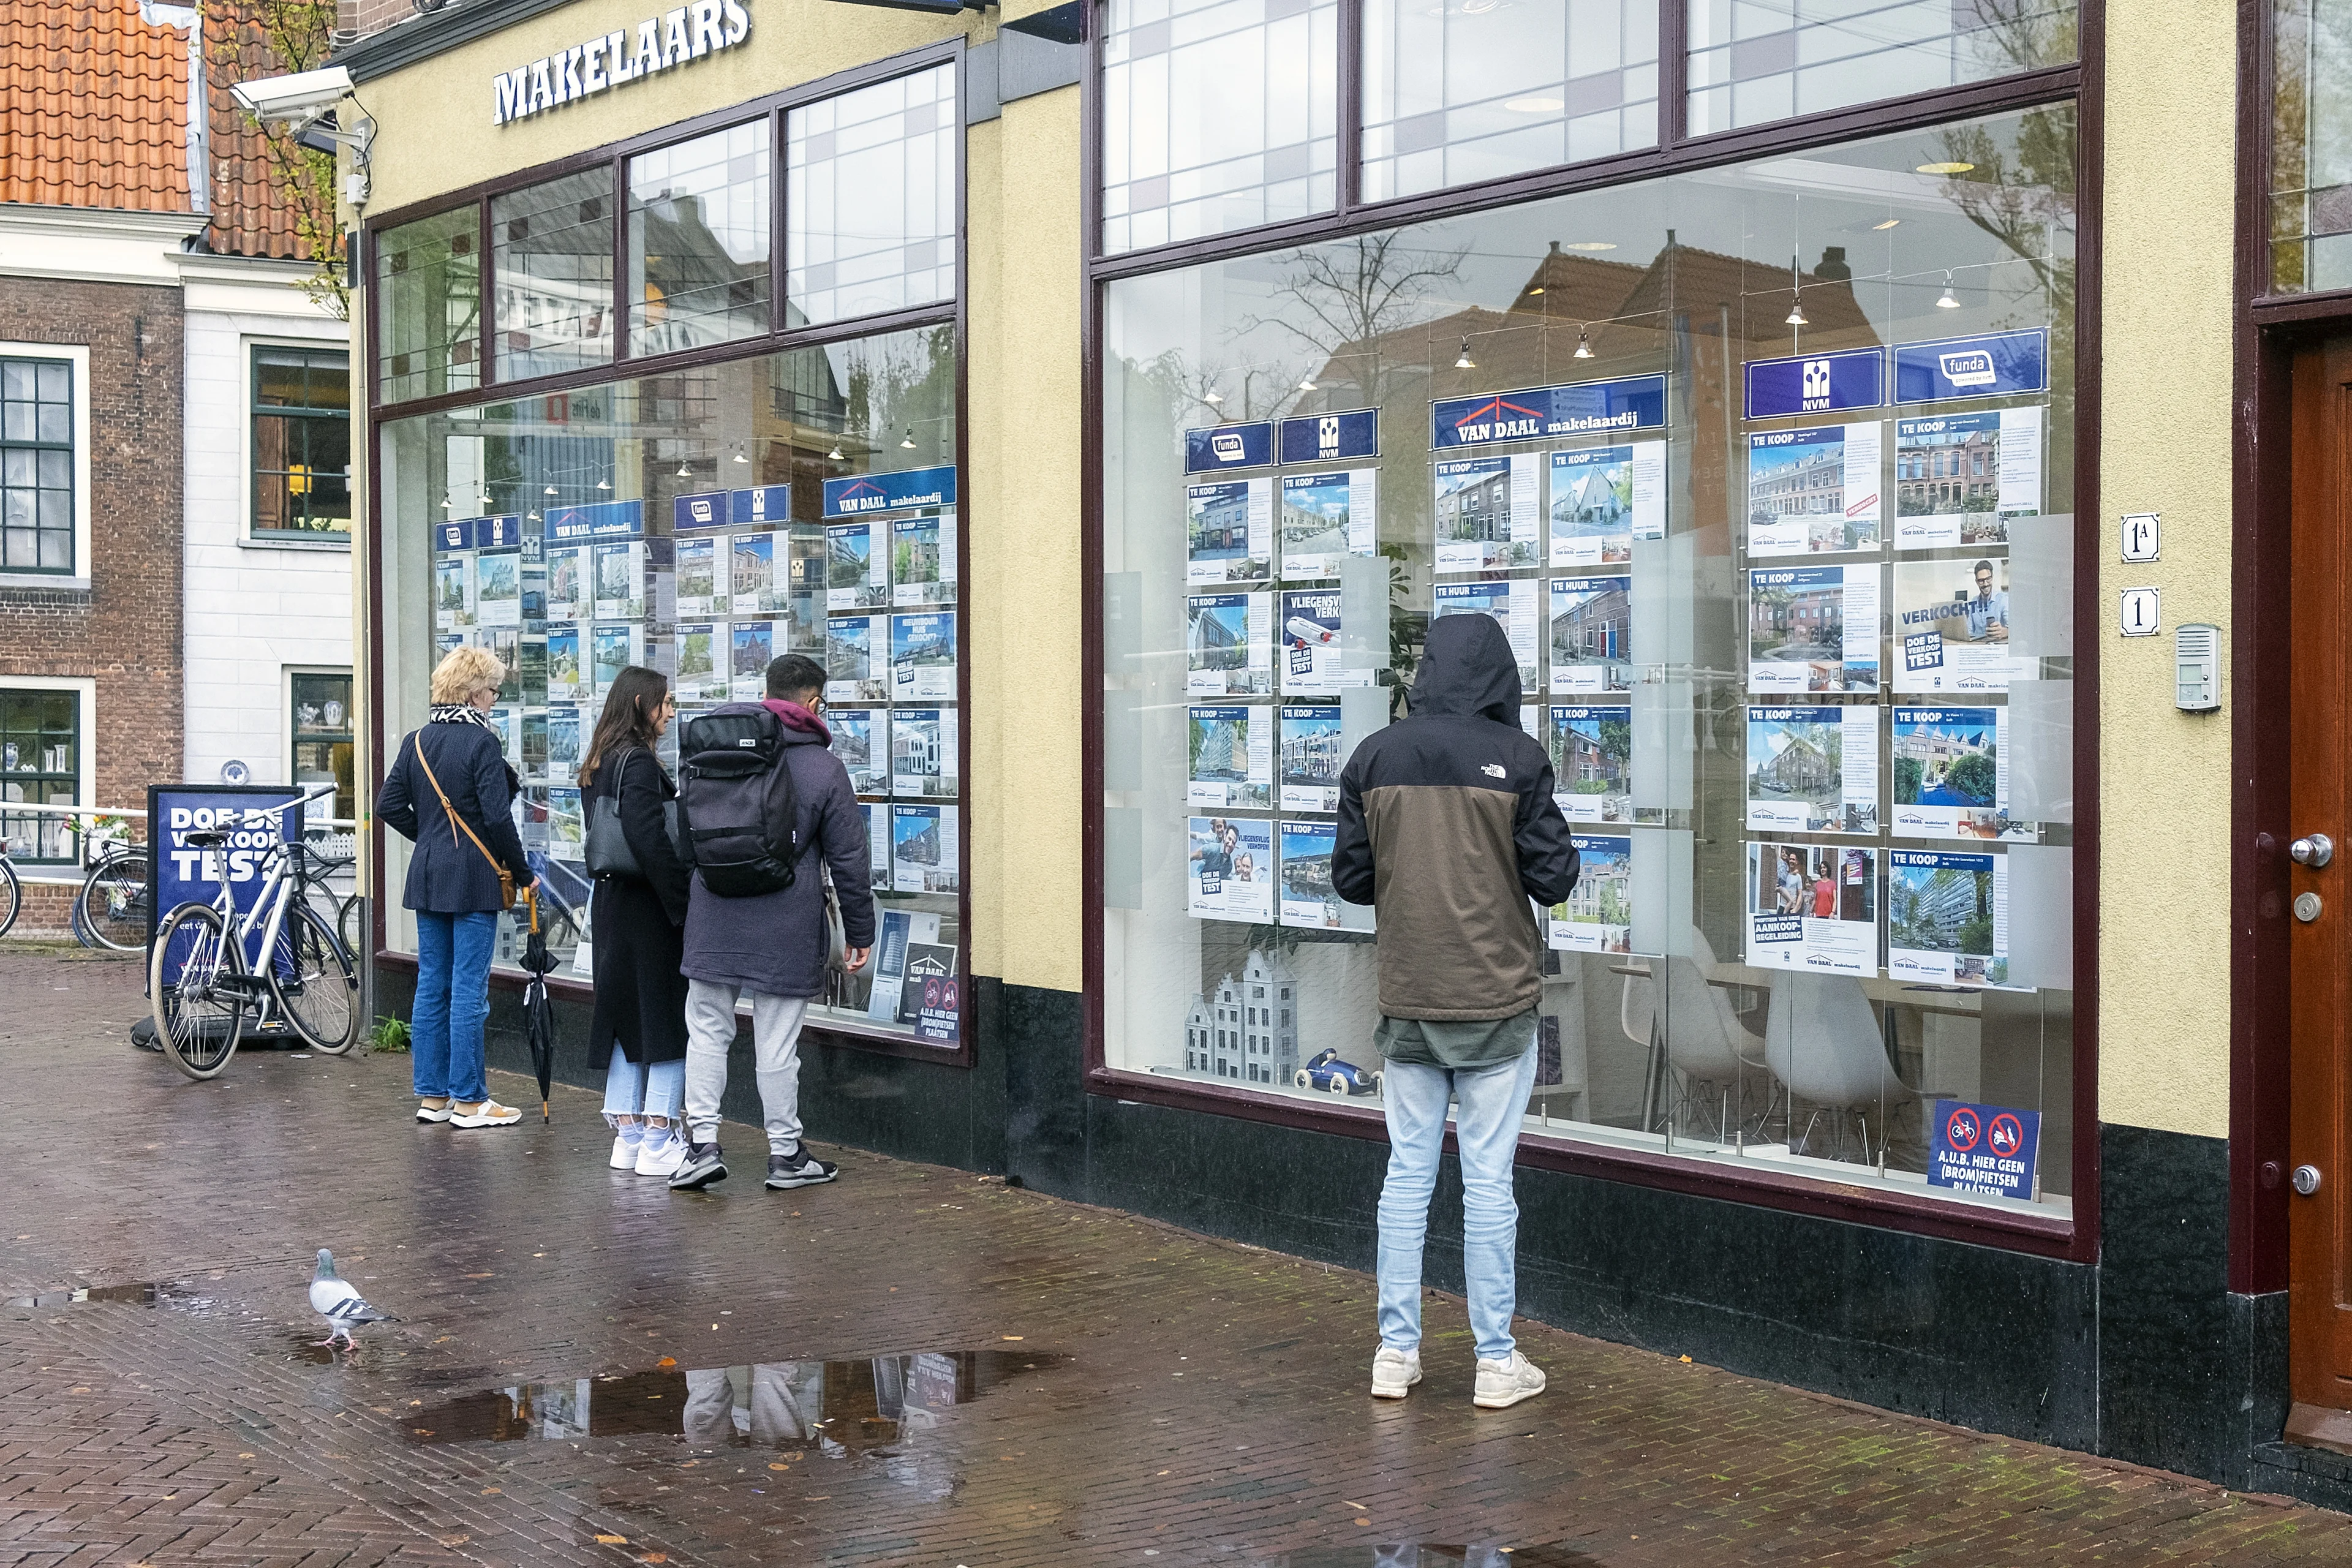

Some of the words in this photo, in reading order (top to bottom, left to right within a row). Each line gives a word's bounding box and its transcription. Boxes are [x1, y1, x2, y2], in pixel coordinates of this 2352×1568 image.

[493, 0, 751, 126] MAKELAARS
[1949, 356, 1985, 372] funda
[1803, 398, 1830, 410] NVM
[1458, 424, 1491, 442] VAN
[1494, 419, 1539, 439] DAAL
[1547, 412, 1637, 432] makelaardij
[1902, 424, 1915, 434] TE
[1917, 421, 1945, 433] KOOP
[1218, 439, 1238, 451] funda
[1753, 436, 1765, 446] TE
[1768, 434, 1794, 445] KOOP
[1319, 448, 1339, 459] NVM
[1556, 457, 1566, 466] TE
[1568, 454, 1590, 464] KOOP
[1439, 466, 1448, 474] TE
[1450, 463, 1471, 472] KOOP
[1295, 478, 1314, 486] KOOP
[1199, 486, 1216, 495] KOOP
[839, 499, 858, 512] VAN
[860, 496, 886, 510] DAAL
[890, 492, 941, 507] makelaardij
[1846, 495, 1877, 515] VERKOCHT
[695, 505, 708, 513] funda
[556, 526, 570, 537] VAN
[571, 524, 590, 535] DAAL
[594, 522, 631, 533] makelaardij
[2132, 522, 2148, 552] 1A
[1754, 575, 1766, 584] TE
[1769, 573, 1795, 583] KOOP
[1449, 587, 1470, 595] HUUR
[1566, 581, 1589, 590] HUUR
[1315, 606, 1341, 618] VERK
[1902, 600, 1988, 625] VERKOCHT!!
[2135, 598, 2143, 626] 1
[1907, 637, 1925, 647] DOE
[1928, 635, 1940, 644] DE
[1907, 643, 1940, 655] VERKOOP
[1907, 651, 1941, 667] TEST
[1292, 662, 1311, 673] TEST
[899, 671, 913, 682] TEST
[1294, 709, 1313, 718] KOOP
[1751, 710, 1763, 719] TE
[1765, 710, 1792, 719] KOOP
[1898, 712, 1910, 722] TE
[1913, 712, 1942, 722] KOOP
[1238, 835, 1269, 844] VLIEGENSVLUG
[1569, 839, 1588, 848] OOP
[1893, 854, 1906, 864] TE
[1909, 854, 1938, 865] KOOP
[1203, 883, 1220, 892] TEST
[1755, 921, 1801, 932] AANKOOP-
[1756, 931, 1801, 941] BEGELEIDING
[911, 965, 925, 974] VAN
[925, 968, 944, 976] DAAL
[920, 1007, 934, 1016] A.U.B.
[935, 1009, 946, 1019] HIER
[946, 1011, 958, 1020] GEEN
[921, 1016, 956, 1030] (BROM)FIETSEN
[925, 1027, 948, 1039] PLAATSEN
[1938, 1150, 1969, 1166] A.U.B.
[1972, 1155, 1995, 1170] HIER
[1998, 1159, 2025, 1174] GEEN
[1942, 1164, 2018, 1188] (BROM)FIETSEN
